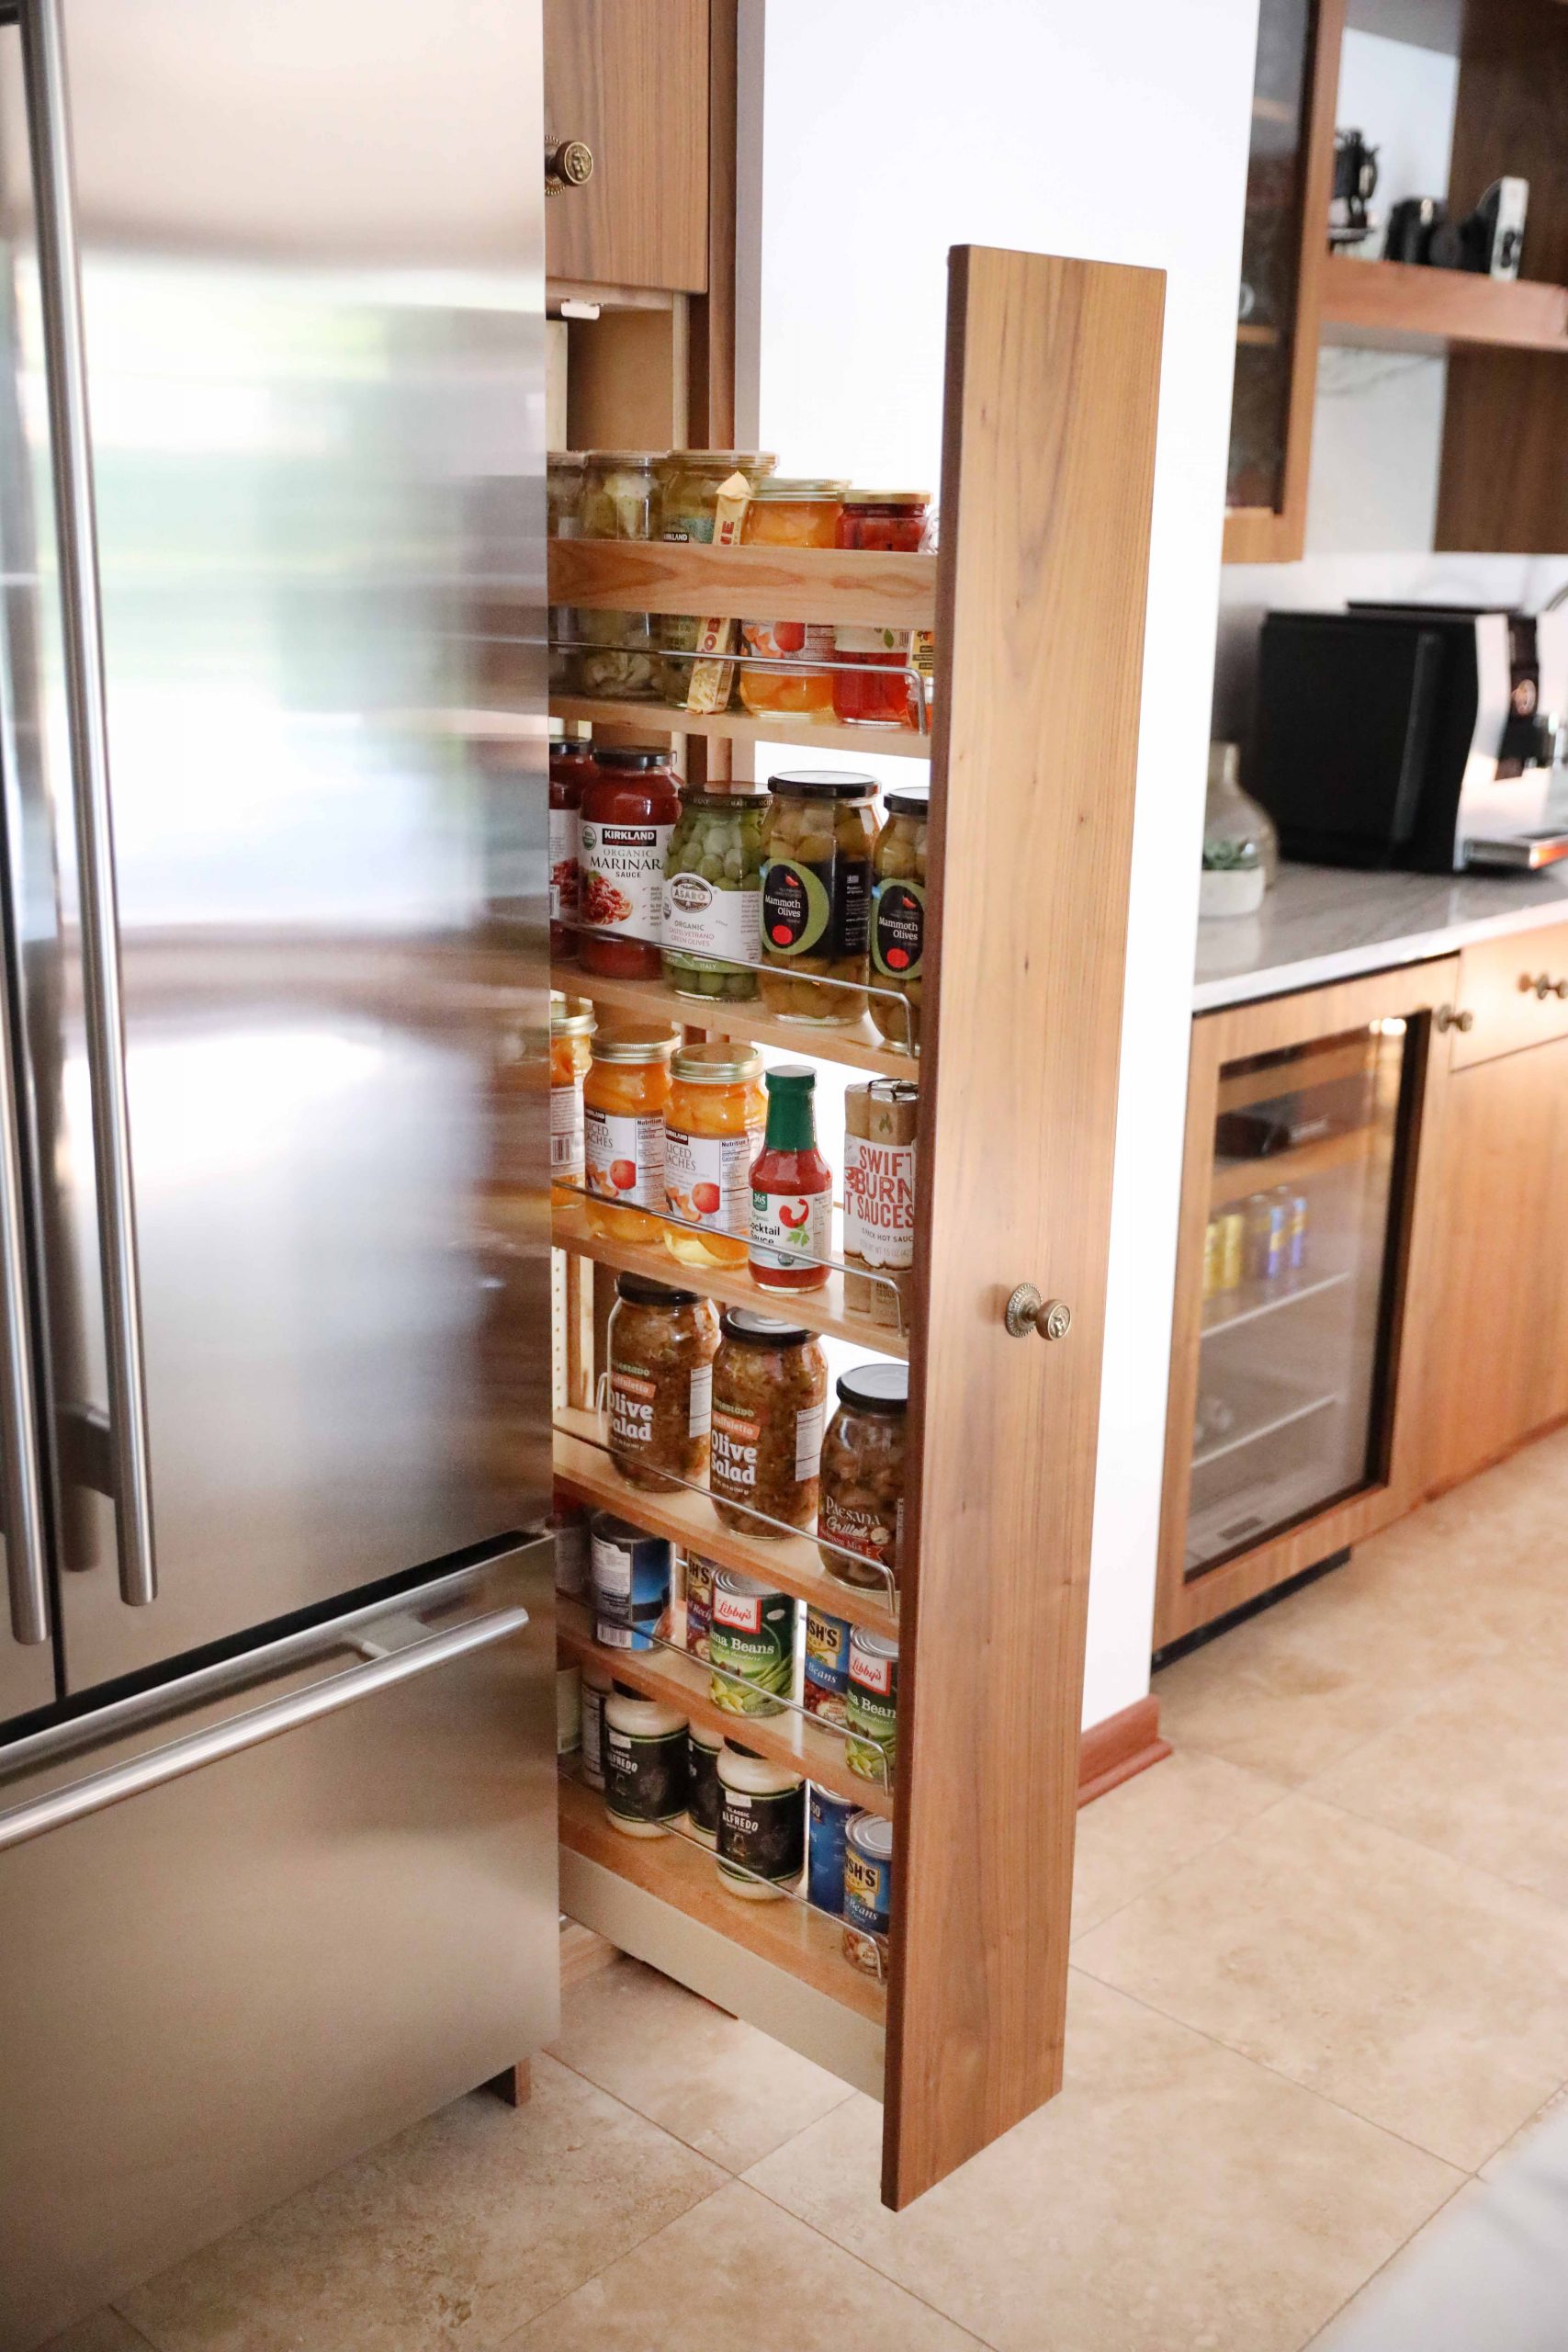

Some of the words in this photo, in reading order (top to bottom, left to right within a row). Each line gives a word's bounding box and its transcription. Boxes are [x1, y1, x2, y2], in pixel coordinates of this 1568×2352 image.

[604, 830, 656, 840] KIRKLAND
[603, 848, 653, 858] ORGANIC
[590, 855, 664, 871] MARINAR
[674, 888, 706, 901] ASARO
[765, 894, 801, 909] Mammoth
[777, 907, 801, 918] Olives
[674, 920, 705, 932] ORGANIC
[879, 916, 919, 932] Mammoth
[893, 929, 919, 941] Olives
[666, 1142, 692, 1159] LICED
[854, 1168, 913, 1204] BURN
[753, 1193, 766, 1206] 365
[857, 1194, 914, 1229] SAUCES
[877, 1234, 891, 1242] HOT
[893, 1235, 914, 1243] SAUC
[613, 1416, 653, 1442] alad
[711, 1429, 758, 1464] Olive
[711, 1451, 757, 1486] Salad
[718, 1601, 751, 1622] Libby's
[807, 1619, 838, 1648] SH'S
[730, 1637, 774, 1655] Beans
[807, 1662, 838, 1684] Beans
[852, 1657, 882, 1682] Libby's
[861, 1696, 897, 1719] Bean
[722, 1811, 759, 1832] ALFREDO
[846, 1855, 876, 1887] SH'S
[849, 1897, 878, 1921] Beans
